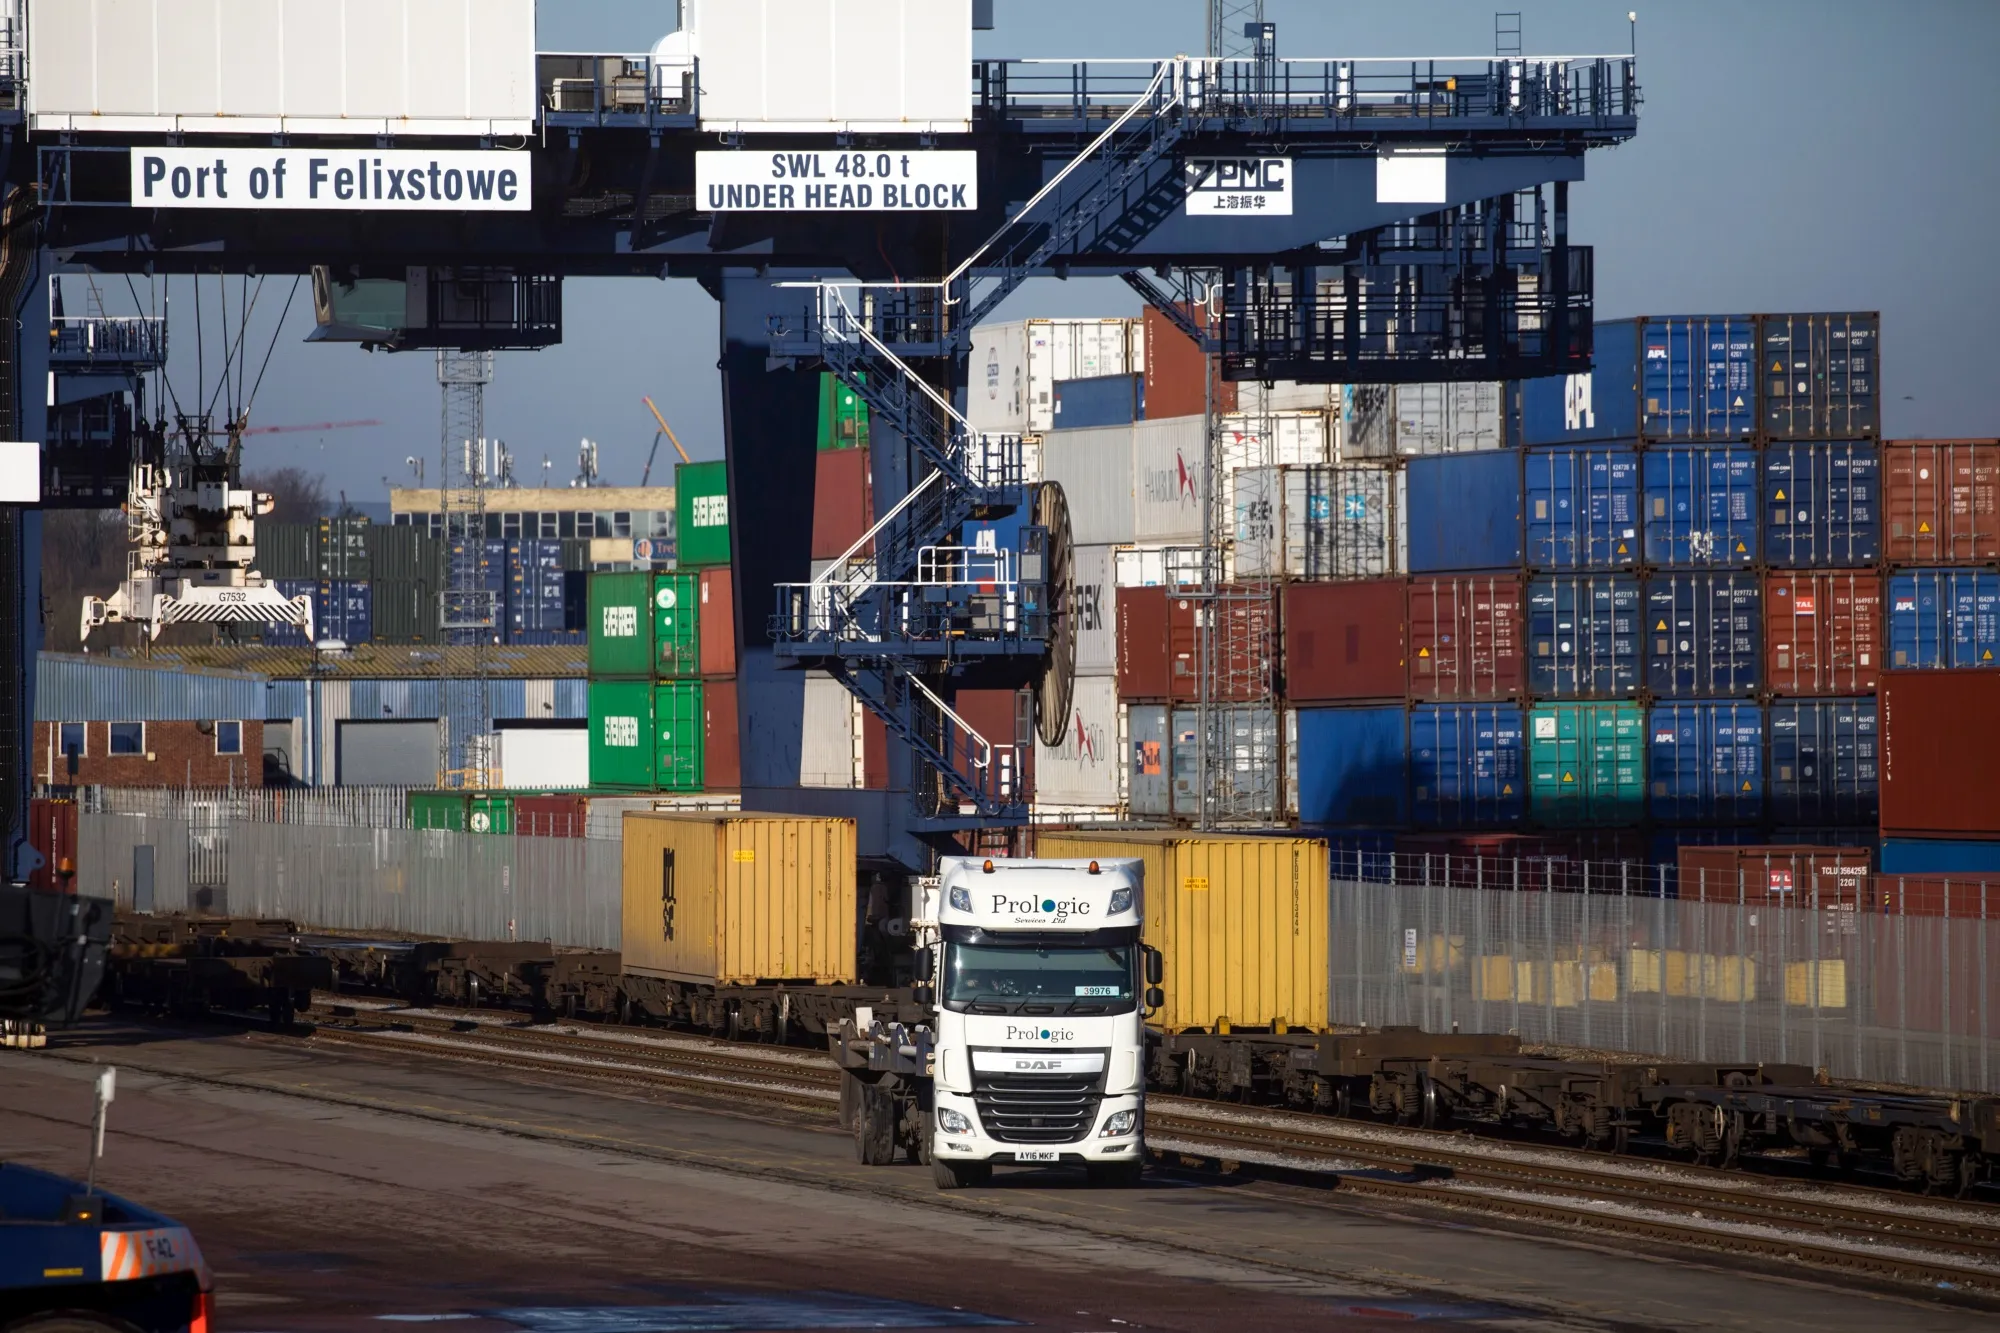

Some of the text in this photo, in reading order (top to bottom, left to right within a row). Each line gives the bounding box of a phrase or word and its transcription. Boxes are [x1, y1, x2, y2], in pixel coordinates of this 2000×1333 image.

[771, 153, 910, 179] SWL 48.0 t
[143, 156, 518, 202] Port of Felixstowe
[1193, 159, 1284, 191] ZPMC
[708, 183, 967, 208] UNDER HEAD BLOCK
[1213, 195, 1266, 209] 上海振华
[1648, 350, 1668, 358] APL
[218, 592, 246, 602] G7532
[1896, 602, 1915, 611] APL
[1655, 734, 1675, 742] APL
[1821, 866, 1838, 875] TCLU
[992, 894, 1090, 918] Prologic
[1006, 1026, 1074, 1043] Prologic
[1016, 1060, 1062, 1070] DAF
[146, 1238, 175, 1260] F42
